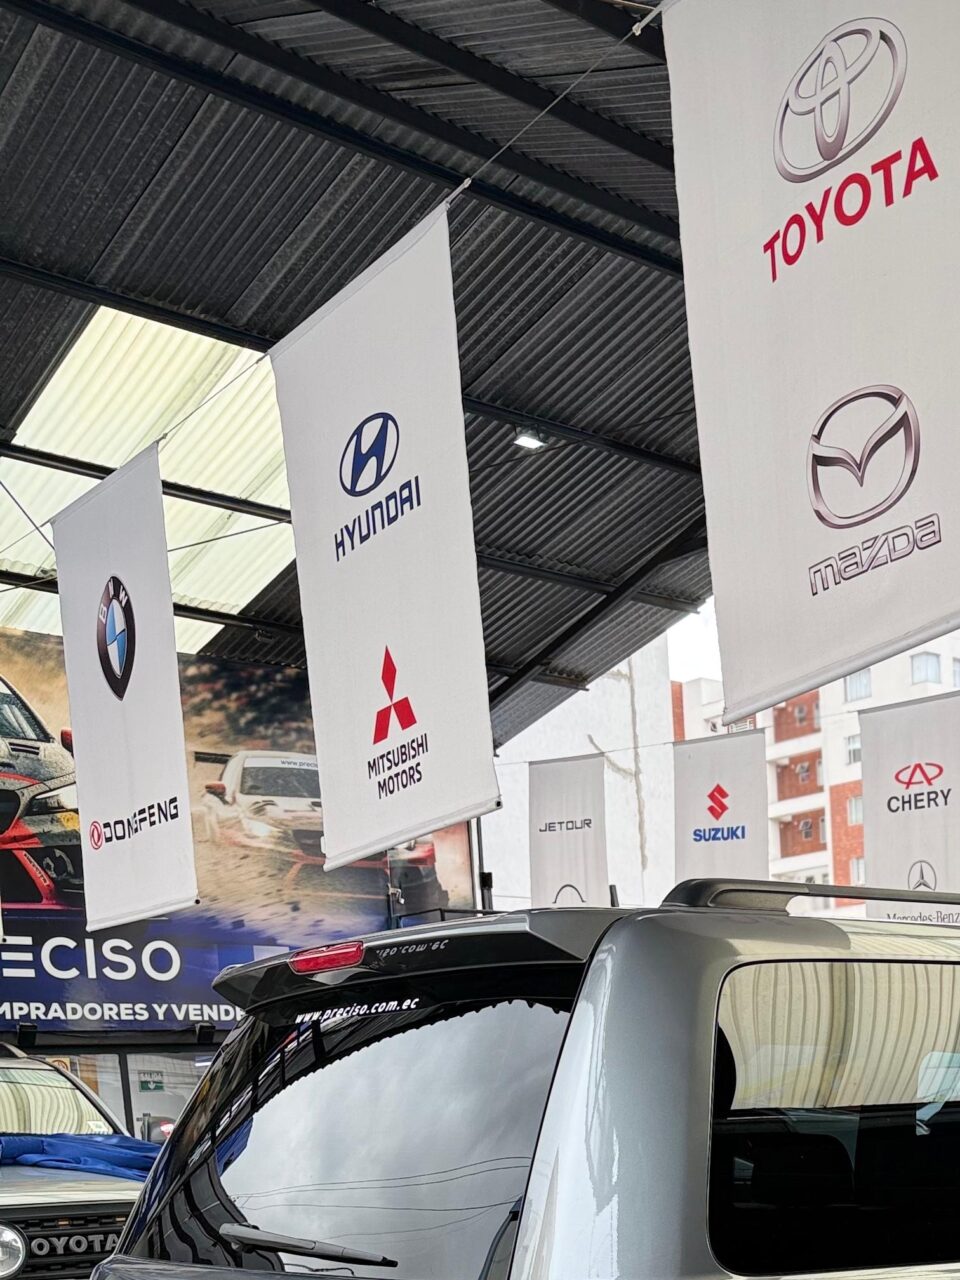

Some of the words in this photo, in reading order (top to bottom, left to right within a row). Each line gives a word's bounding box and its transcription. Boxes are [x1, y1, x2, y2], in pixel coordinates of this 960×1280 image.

[763, 136, 940, 284] TOYOTA
[334, 475, 422, 563] HYUNDAI
[367, 732, 429, 780] MITSUBISHI
[377, 761, 423, 800] MOTORS
[886, 788, 952, 814] CHERY
[102, 796, 179, 844] DONGFENG
[538, 818, 592, 833] JETOUR
[692, 825, 746, 843] SUZUKI
[152, 1004, 168, 1021] Y
[295, 998, 420, 1023] www.preciso.com.ec
